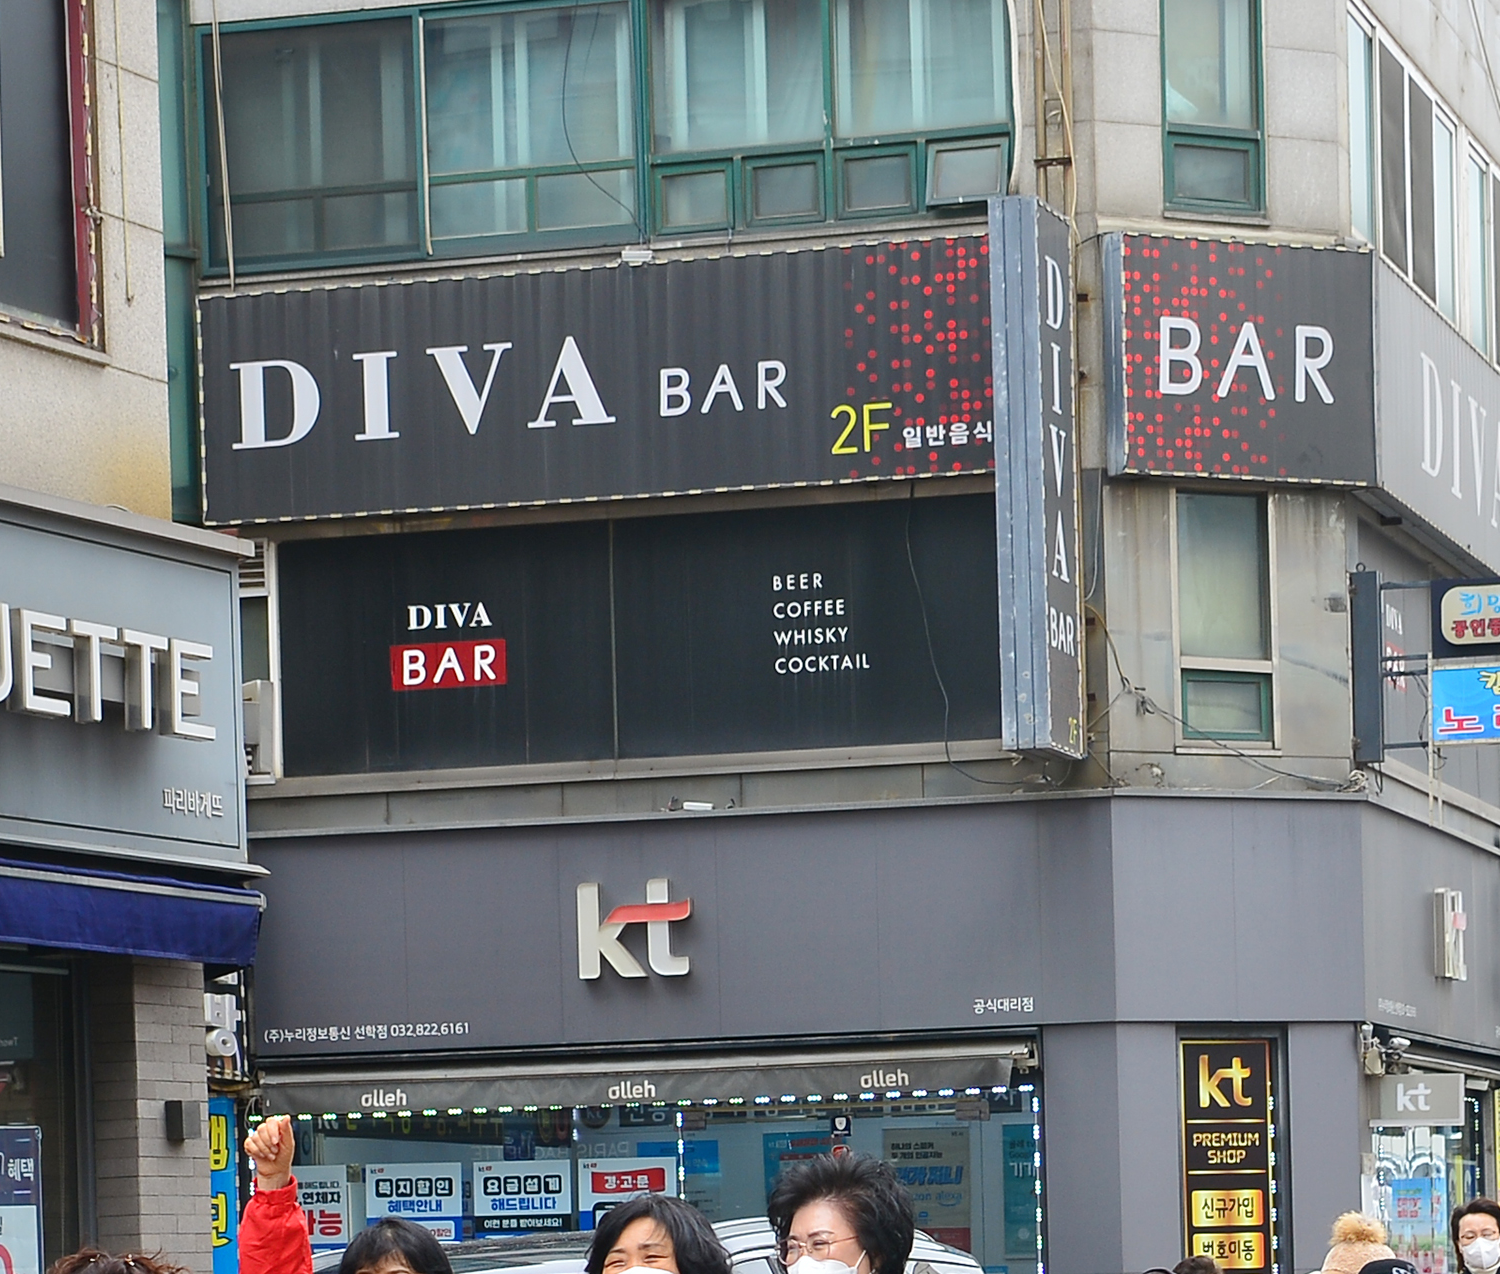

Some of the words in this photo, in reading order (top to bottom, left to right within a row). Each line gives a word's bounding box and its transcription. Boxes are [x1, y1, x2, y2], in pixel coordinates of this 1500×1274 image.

[1158, 316, 1335, 405] BAR
[229, 335, 616, 452] DIVA
[658, 359, 788, 419] BAR
[831, 401, 892, 457] 2F
[1044, 252, 1071, 585] DIVA
[772, 572, 824, 592] BEER
[406, 601, 492, 631] DIVA
[772, 597, 847, 619] COFFEE
[774, 625, 848, 648] WHISKY
[402, 642, 499, 688] BAR
[774, 652, 871, 676] COCKTAIL
[162, 788, 224, 820] 파리바게뜨
[575, 877, 691, 981] kt
[972, 996, 1035, 1014] 공식대리점
[263, 1023, 350, 1044] (주)누리정보통신
[353, 1022, 389, 1041] 선학점
[608, 1079, 657, 1100] olleh
[860, 1068, 910, 1090] olleh
[1198, 1055, 1252, 1110] kt
[360, 1087, 408, 1109] olleh
[1397, 1083, 1432, 1112] kt
[1192, 1132, 1260, 1149] PREMIUM
[1206, 1149, 1246, 1165] SHOP
[7, 1158, 35, 1181] 혜택
[376, 1178, 452, 1197] 복지할인
[486, 1177, 561, 1193] 요금설계
[387, 1200, 442, 1213] 혜택안내
[491, 1198, 557, 1211] 해드립니다
[1201, 1194, 1255, 1223] 신규가입
[1201, 1237, 1256, 1263] 번호이동
